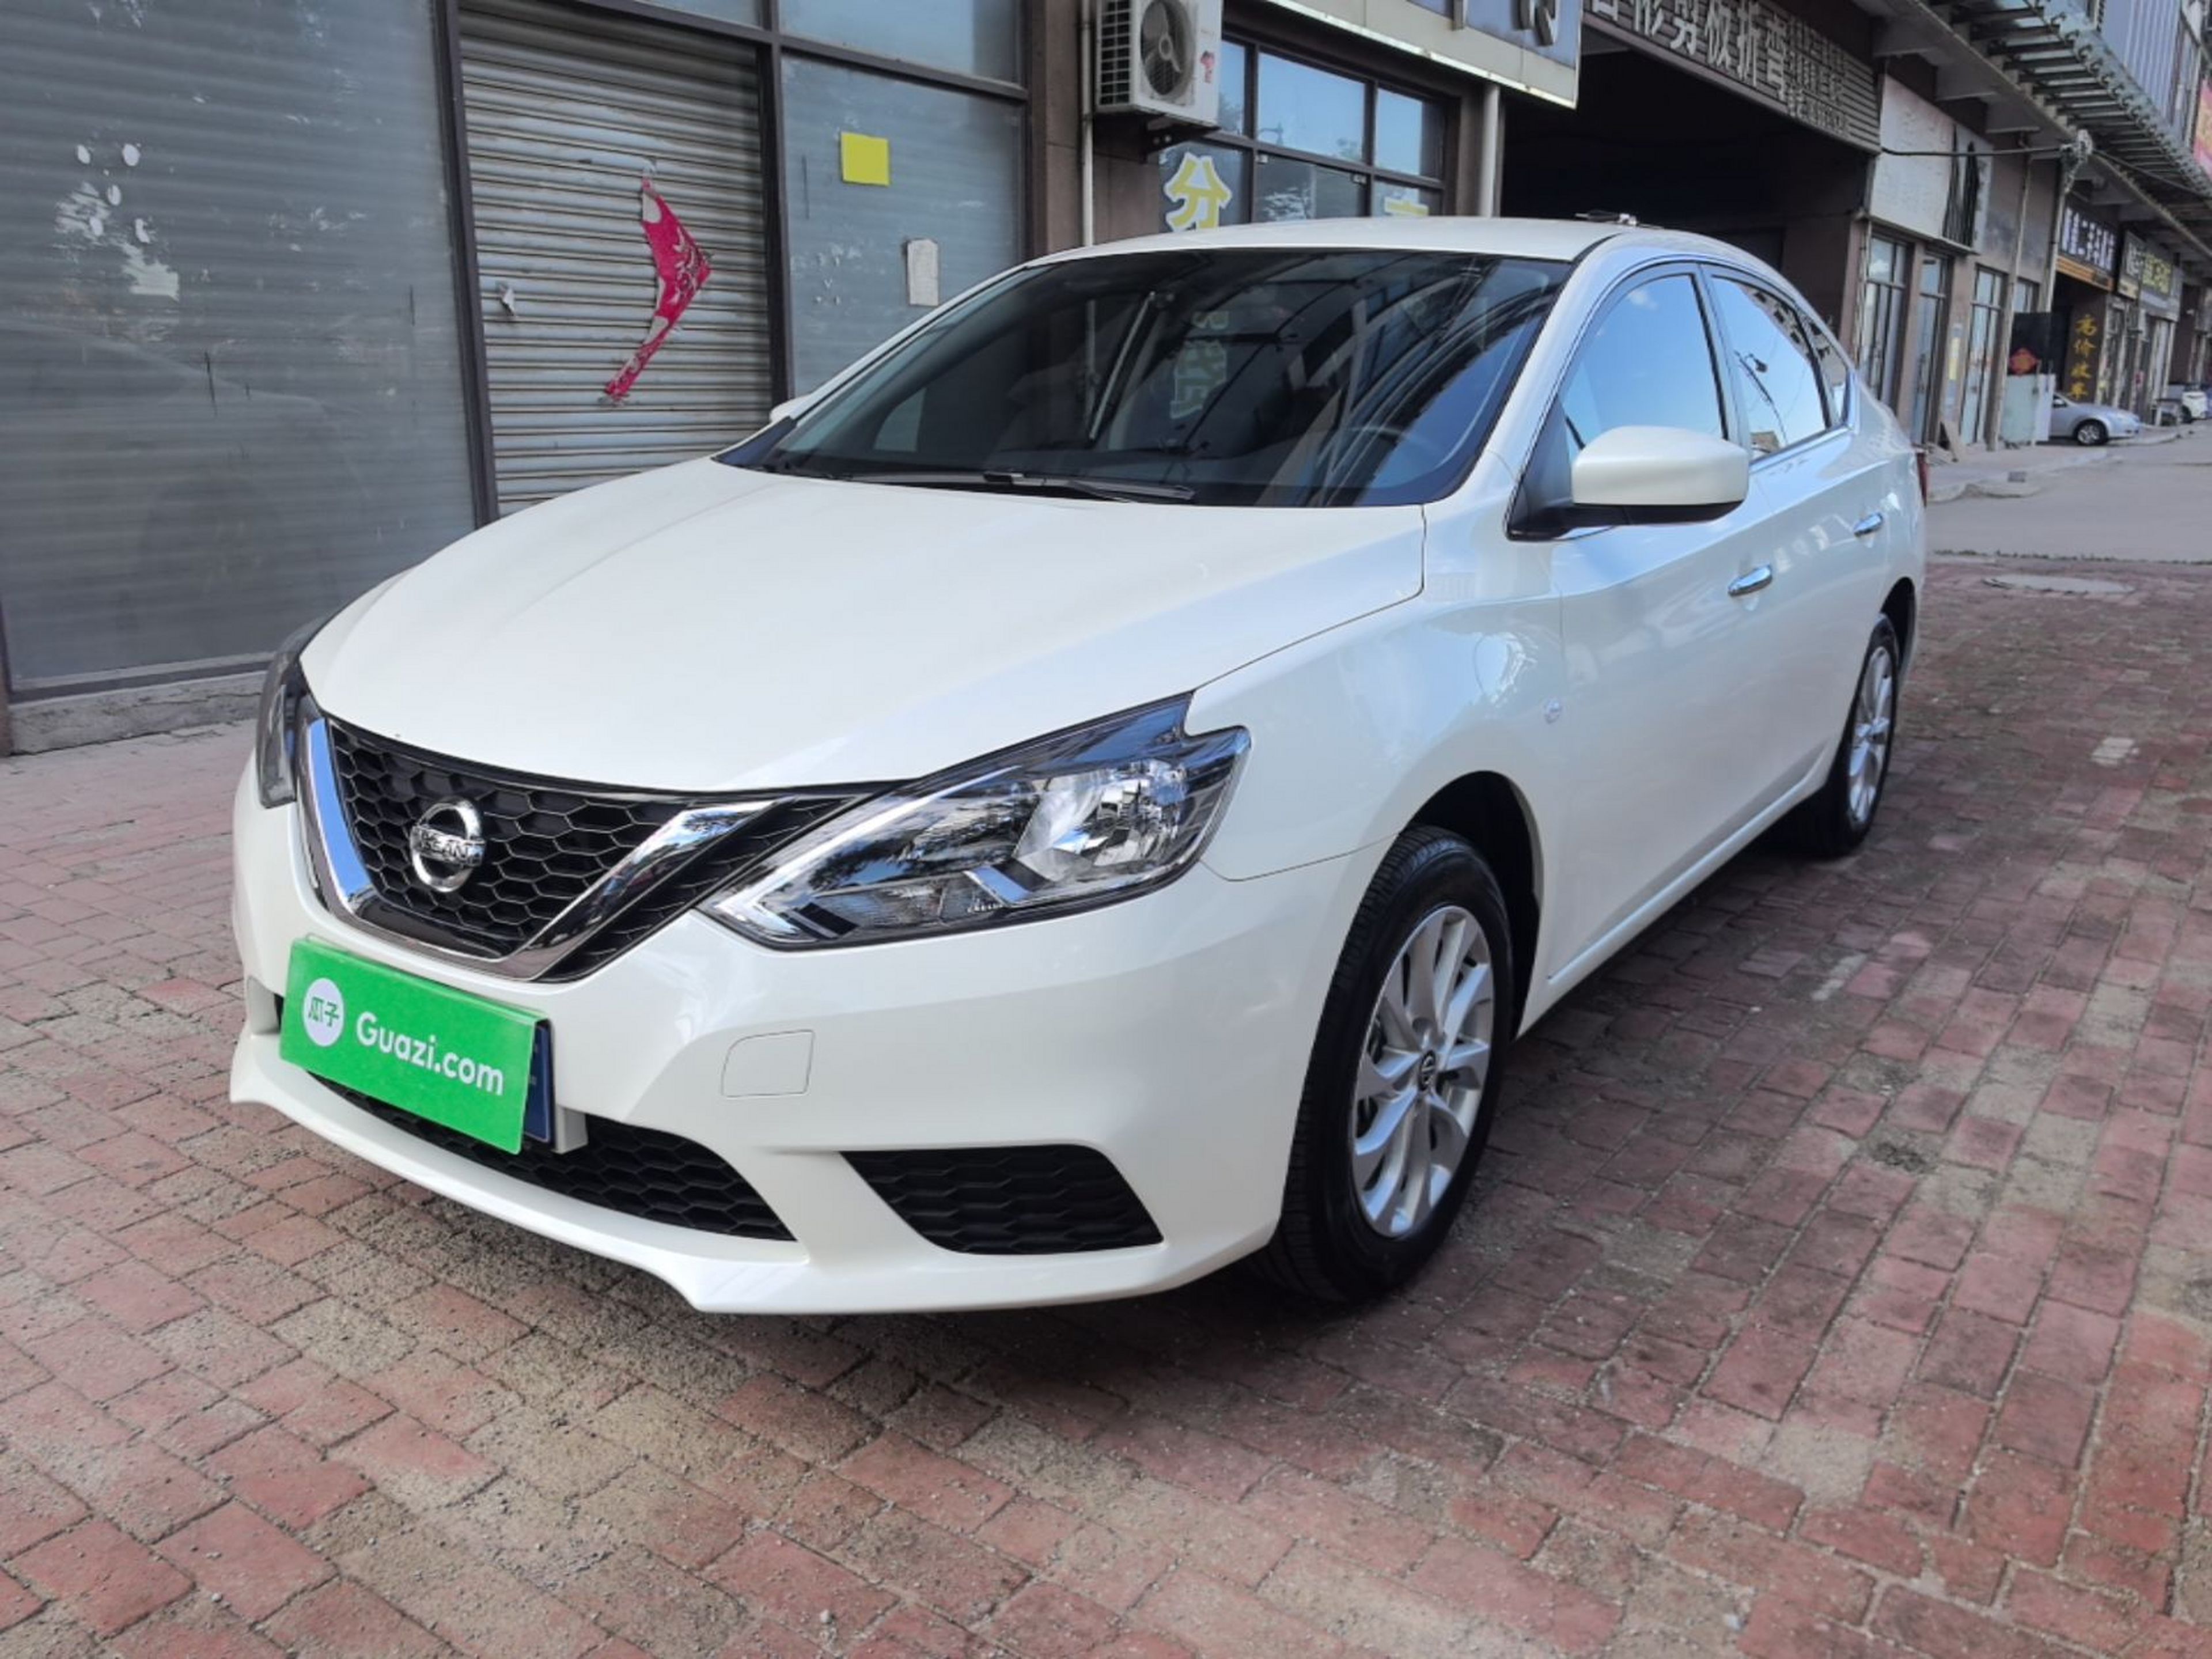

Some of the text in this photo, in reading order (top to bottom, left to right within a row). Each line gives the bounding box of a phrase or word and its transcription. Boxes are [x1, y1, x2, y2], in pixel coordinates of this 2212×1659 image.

[1164, 152, 1232, 232] 分
[308, 996, 339, 1027] 瓜子
[356, 1011, 504, 1096] Guazi.com
